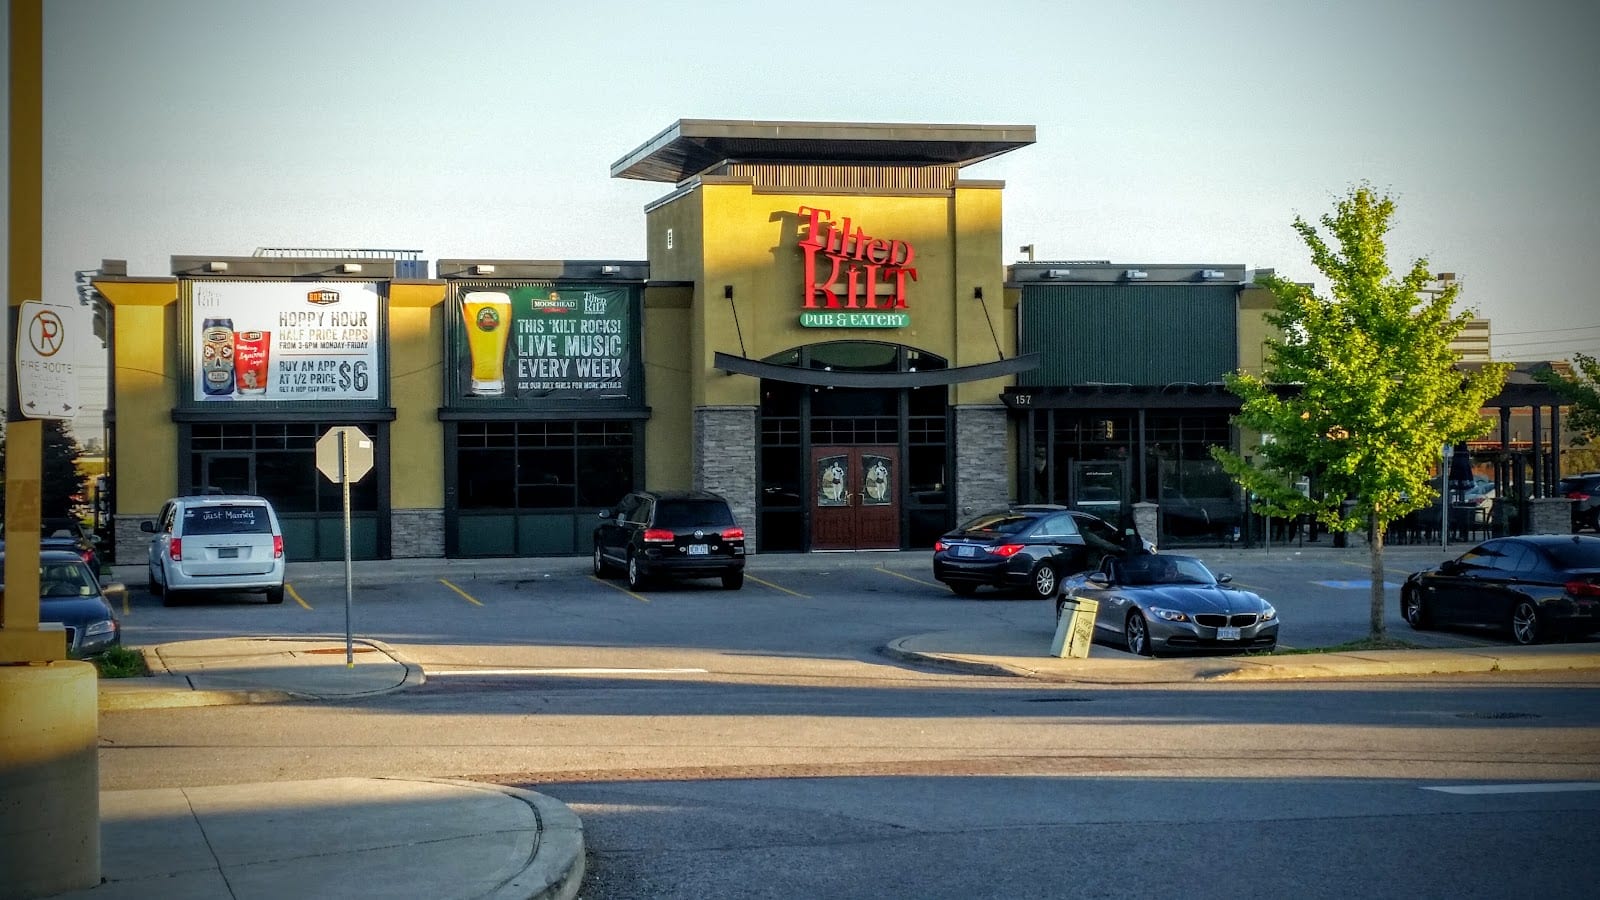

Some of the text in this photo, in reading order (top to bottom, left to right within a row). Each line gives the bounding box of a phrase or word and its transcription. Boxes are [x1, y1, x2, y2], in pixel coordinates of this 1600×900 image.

[534, 300, 576, 308] MOOSEHEAD
[279, 311, 368, 327] HOPPY HOUR
[805, 313, 833, 326] PUB
[836, 313, 847, 326] &
[517, 319, 545, 334] THIS
[580, 319, 622, 334] ROCKS!
[279, 328, 368, 341] HALF PRICE APPS
[279, 341, 297, 349] FROM
[320, 341, 368, 349] MONDAY-FRIDAY
[518, 335, 622, 357] LIVE MUSIC
[20, 360, 73, 375] FIRE ROUTE
[279, 360, 337, 372] BUY AN APP
[518, 358, 622, 378] EVERY WEEK
[279, 373, 337, 385] AT 1/2 PRICE
[338, 360, 369, 392] $6
[1015, 395, 1032, 405] 157
[203, 509, 255, 520] Just Married
